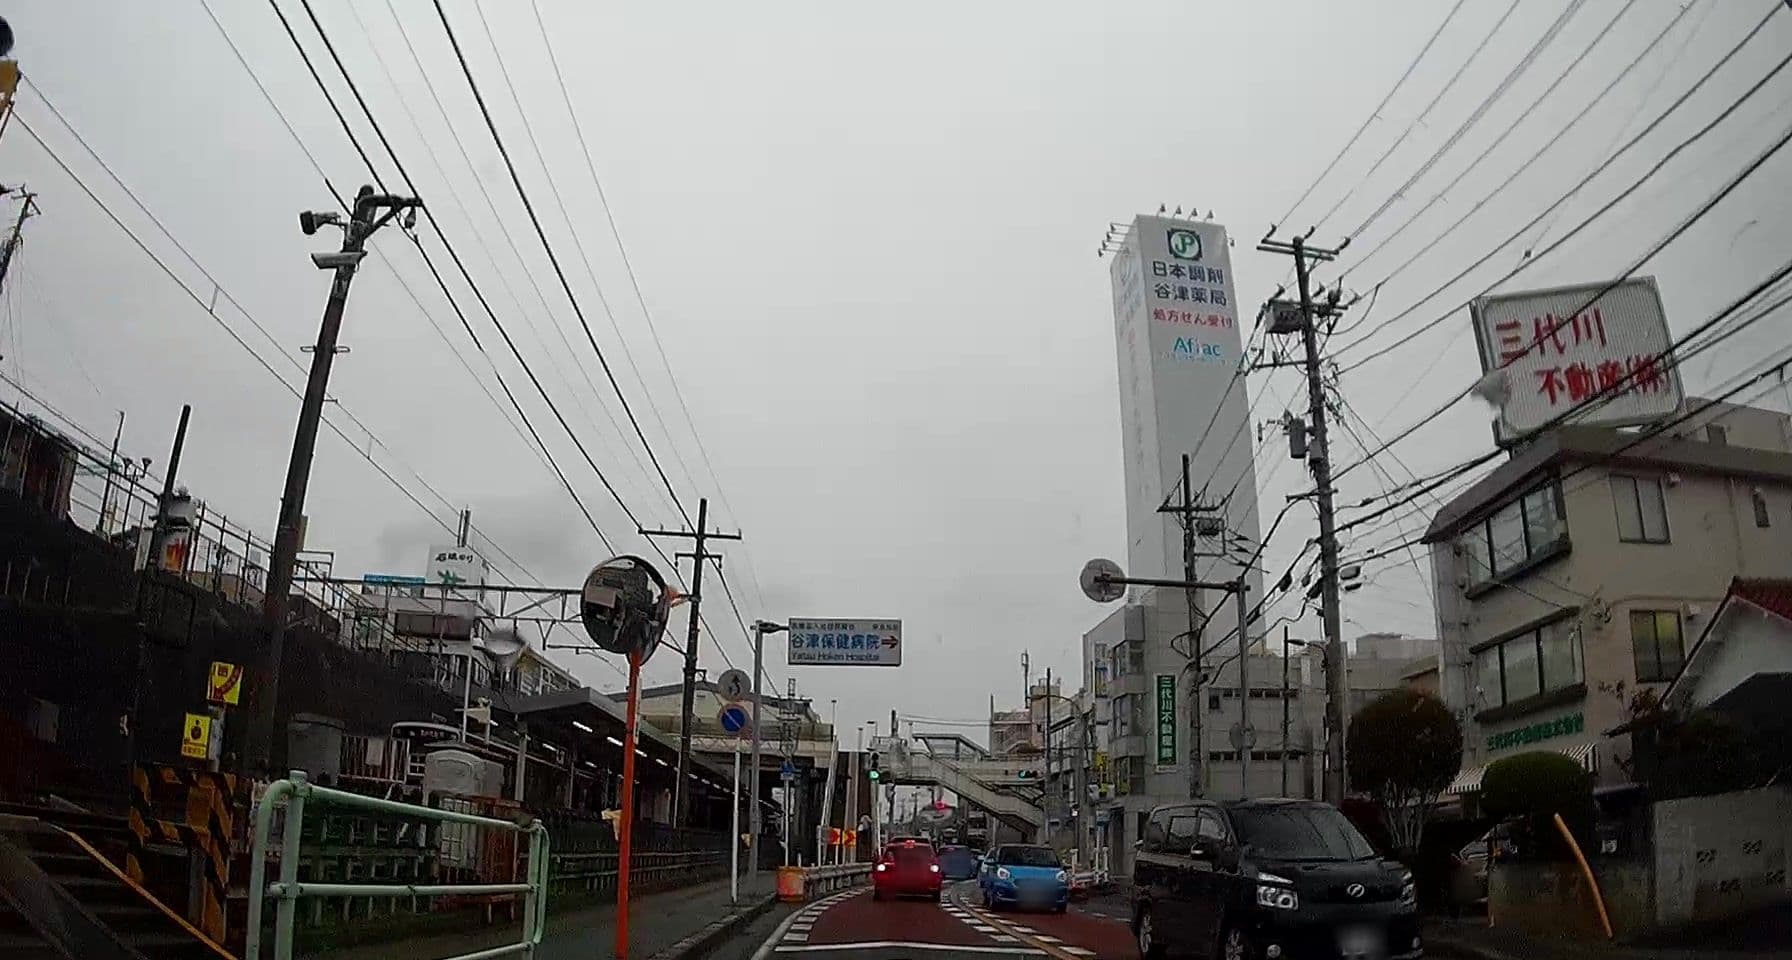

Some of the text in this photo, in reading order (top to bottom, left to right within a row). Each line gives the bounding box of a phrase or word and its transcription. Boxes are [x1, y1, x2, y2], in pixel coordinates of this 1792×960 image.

[1152, 260, 1224, 285] 日本調剤
[1153, 282, 1228, 307] 谷津薬局
[1152, 307, 1233, 329] 処方せん受付
[1495, 305, 1607, 359] 三代川
[791, 633, 880, 650] 谷津保健病院
